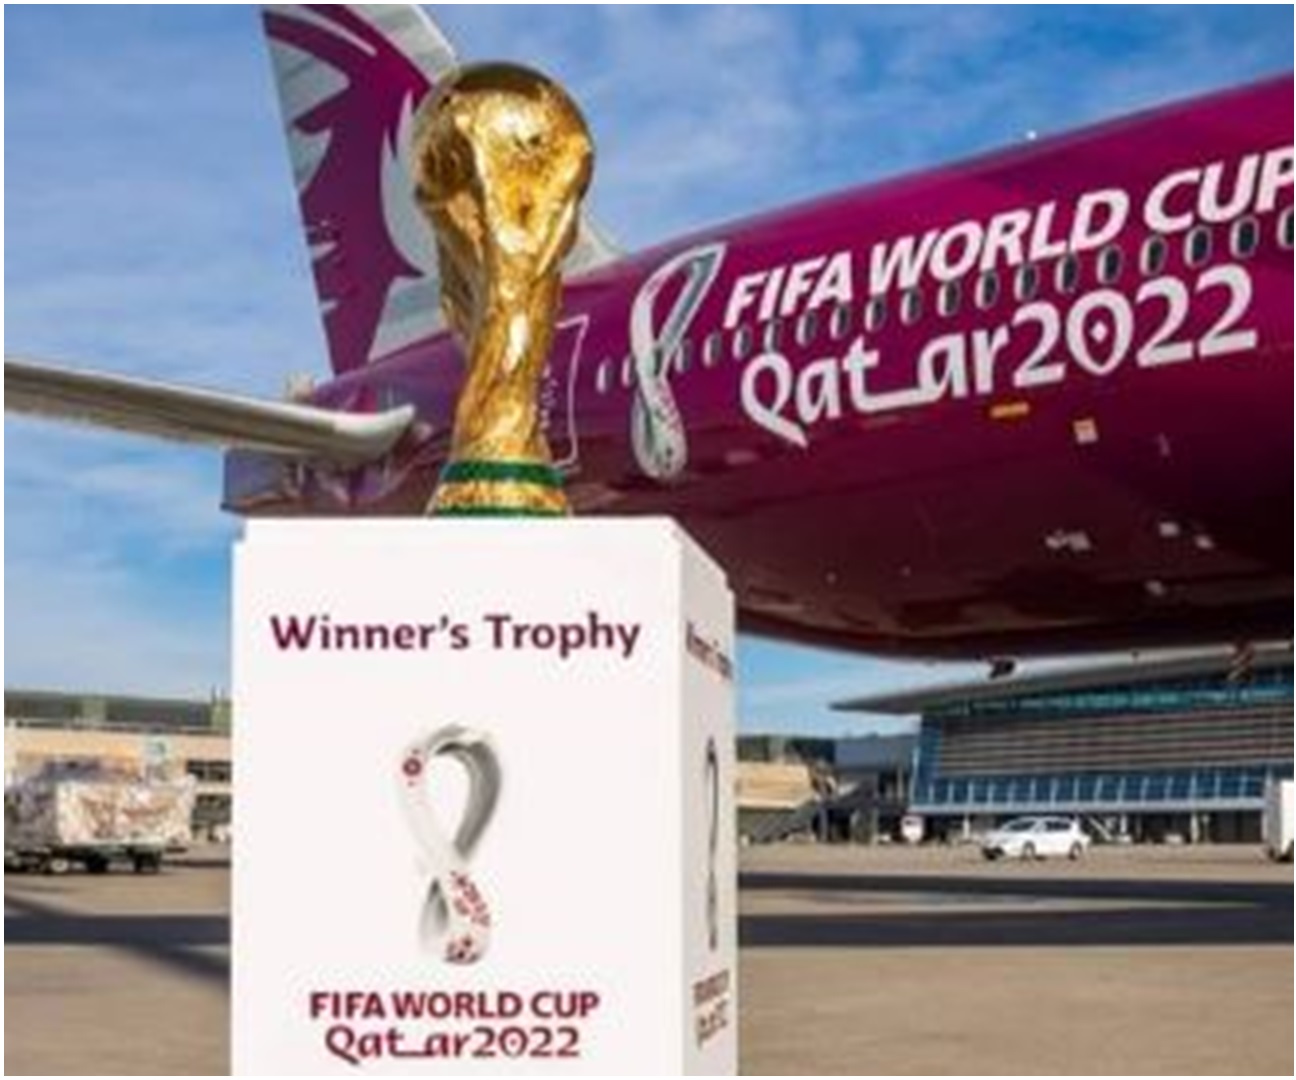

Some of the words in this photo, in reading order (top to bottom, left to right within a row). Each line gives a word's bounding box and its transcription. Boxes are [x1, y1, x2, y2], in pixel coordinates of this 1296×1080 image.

[724, 251, 854, 330] FIFA
[868, 188, 1130, 296] WORLD
[1143, 146, 1294, 234] CUP
[270, 614, 471, 651] Winner's
[483, 611, 641, 660] Trophy
[309, 991, 387, 1019] FIFA
[393, 991, 523, 1019] WORLD
[530, 991, 601, 1019] CUP
